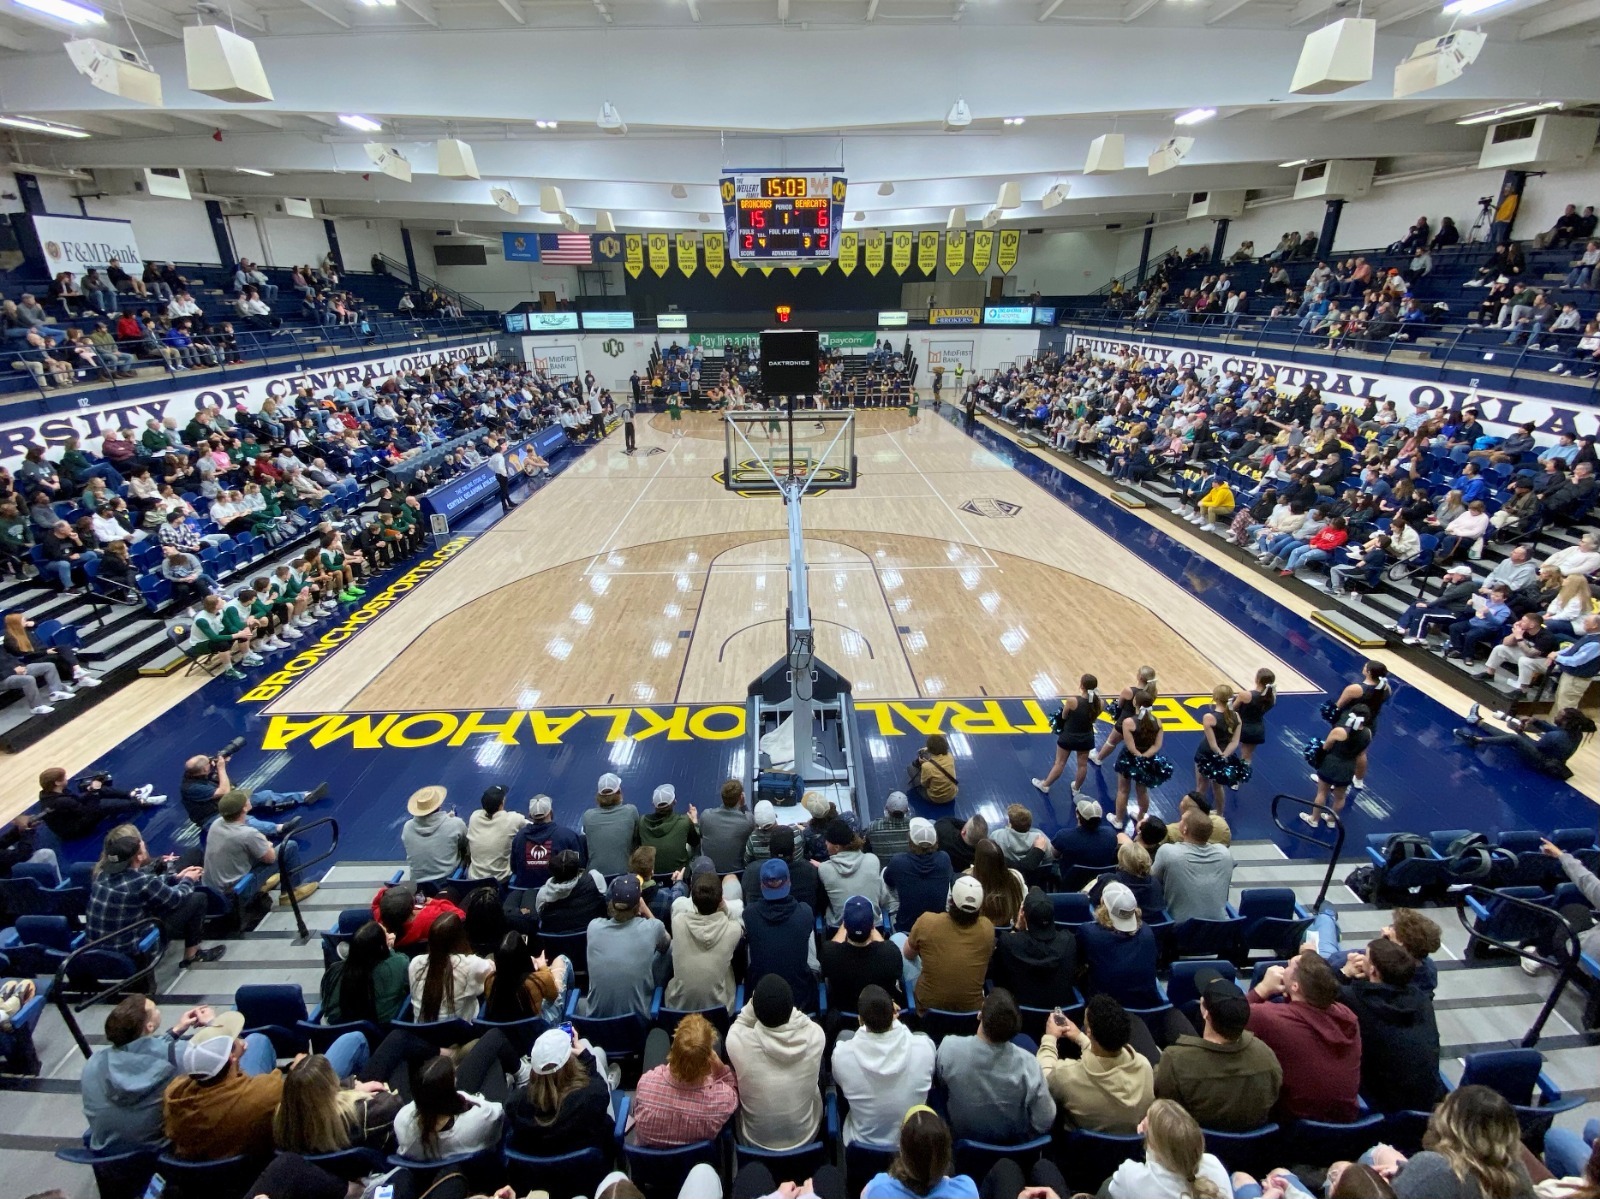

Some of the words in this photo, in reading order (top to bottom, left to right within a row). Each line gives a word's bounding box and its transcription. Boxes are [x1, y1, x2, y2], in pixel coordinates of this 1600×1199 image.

[768, 179, 806, 197] 15:03
[741, 200, 772, 209] BRONCHOS
[795, 199, 827, 208] BEARCATS
[751, 211, 765, 228] 15
[784, 212, 789, 225] 1
[819, 210, 828, 227] 6
[745, 235, 753, 248] 2
[804, 237, 811, 248] 3
[819, 234, 827, 248] 2
[61, 241, 102, 263] F&M
[100, 243, 140, 264] Bank
[932, 309, 980, 317] TEXTBOOK
[602, 338, 625, 358] UCO
[700, 334, 716, 349] Pay
[717, 334, 733, 347] like
[734, 338, 740, 346] a
[195, 385, 250, 411] OF
[265, 361, 393, 399] CENTRAL
[401, 344, 488, 371] OKLAHOMA
[1180, 351, 1213, 370] OF
[1222, 358, 1388, 402] CENTRAL
[1409, 384, 1600, 441] OKLA
[446, 496, 466, 510] CENTRAL
[463, 484, 484, 499] OKLAHOMA
[482, 475, 498, 488] ATHLETIC
[236, 535, 476, 704] BRONCHOSPORTS.COM
[261, 705, 747, 750] OKLAHOMA
